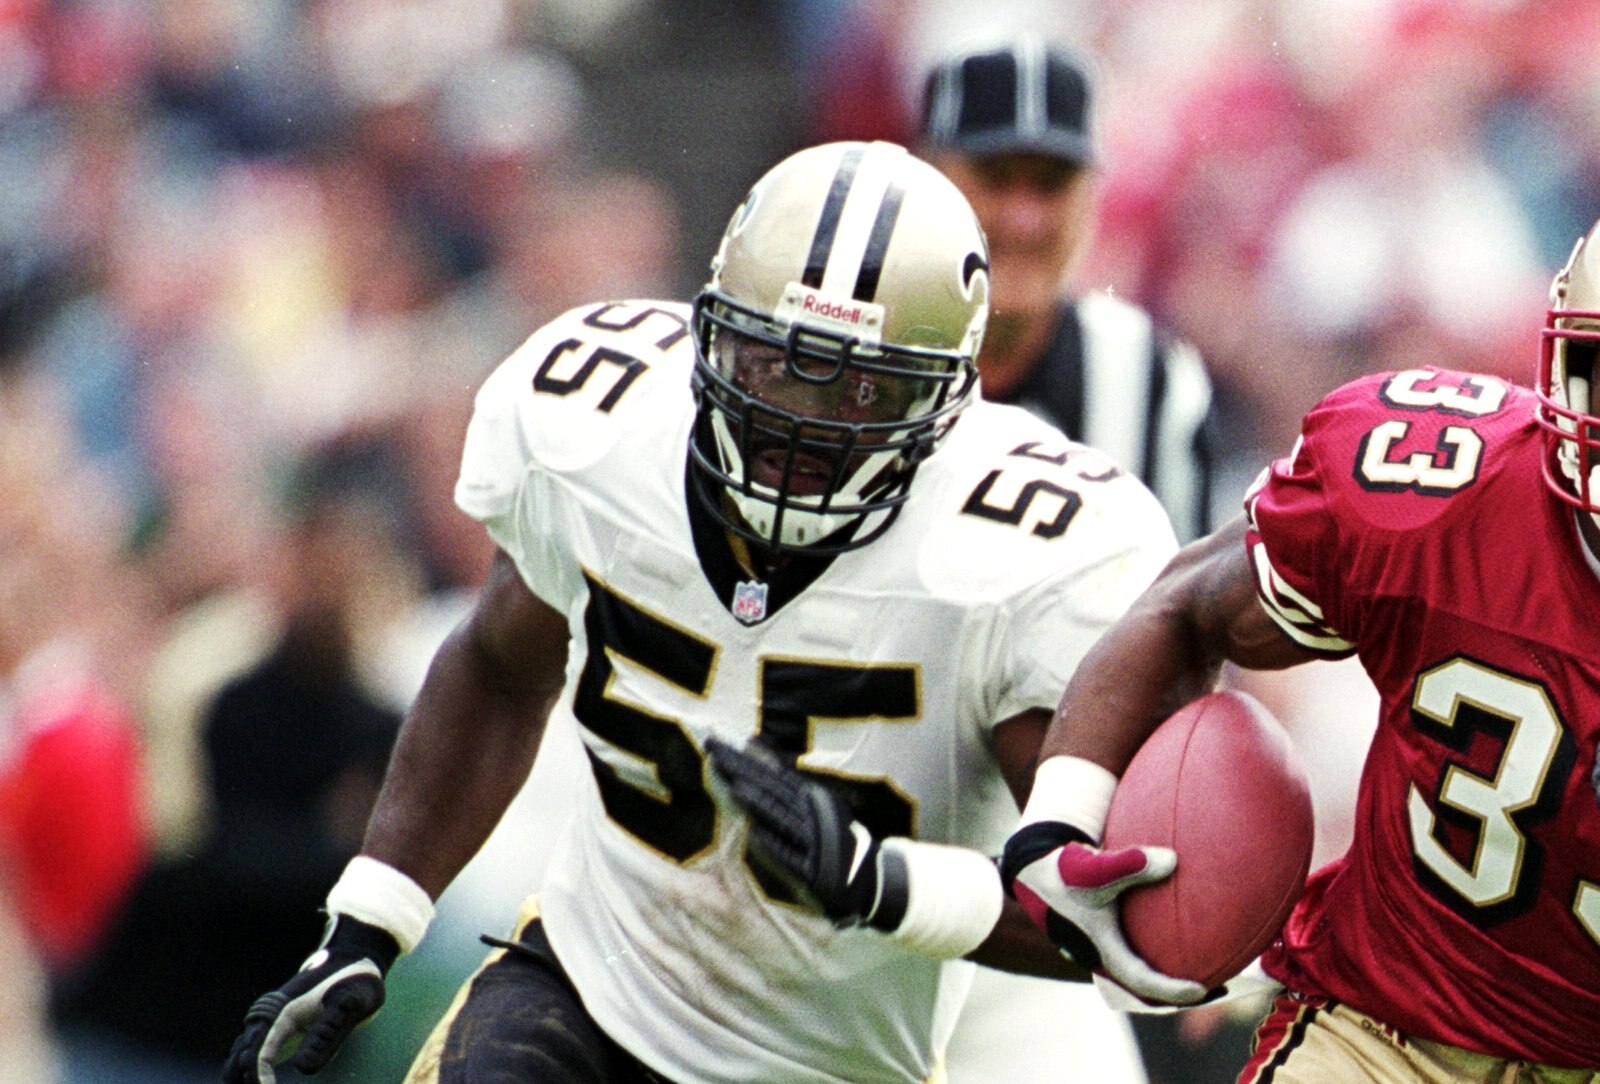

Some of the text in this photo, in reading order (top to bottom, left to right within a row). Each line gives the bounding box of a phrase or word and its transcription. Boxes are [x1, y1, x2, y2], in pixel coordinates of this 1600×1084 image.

[532, 303, 690, 415] 55
[803, 294, 861, 324] Riddell
[1354, 370, 1507, 497] 33
[573, 561, 922, 918] 55
